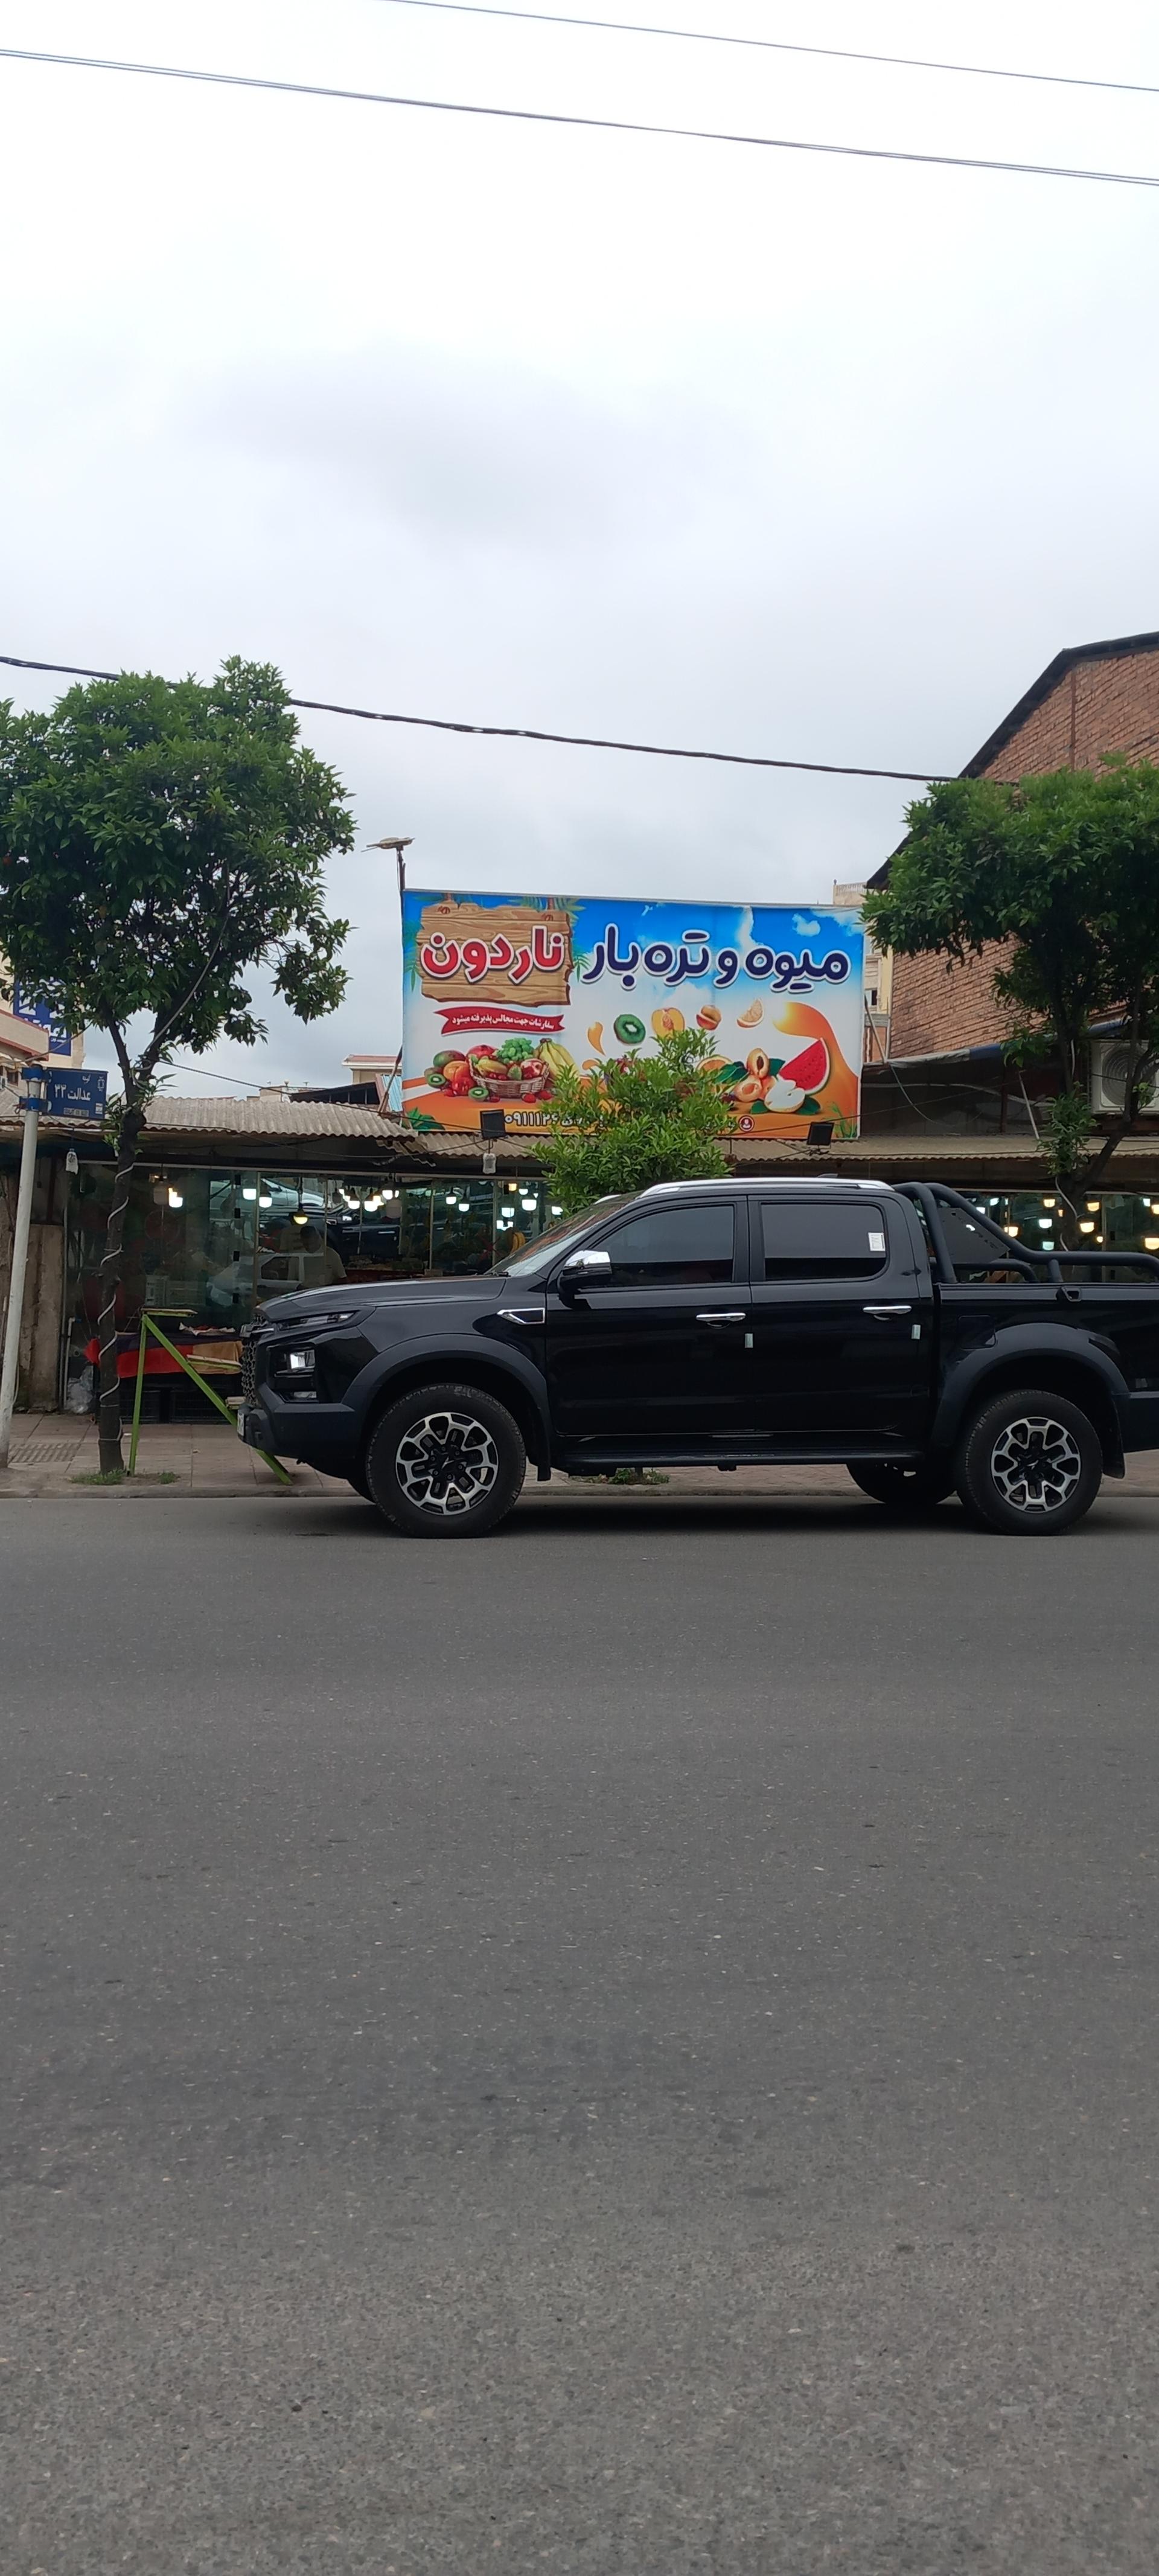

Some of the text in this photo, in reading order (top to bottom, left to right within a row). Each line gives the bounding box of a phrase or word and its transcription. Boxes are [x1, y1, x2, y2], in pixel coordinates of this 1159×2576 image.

[422, 926, 563, 982] ناردون
[714, 948, 739, 987] و
[744, 946, 850, 992] میوه
[471, 1012, 492, 1024] پذیرفته
[493, 1014, 514, 1024] مجالس
[514, 1018, 529, 1026] جهت
[529, 1018, 554, 1029] سفارشات
[67, 1087, 91, 1101] عدالت
